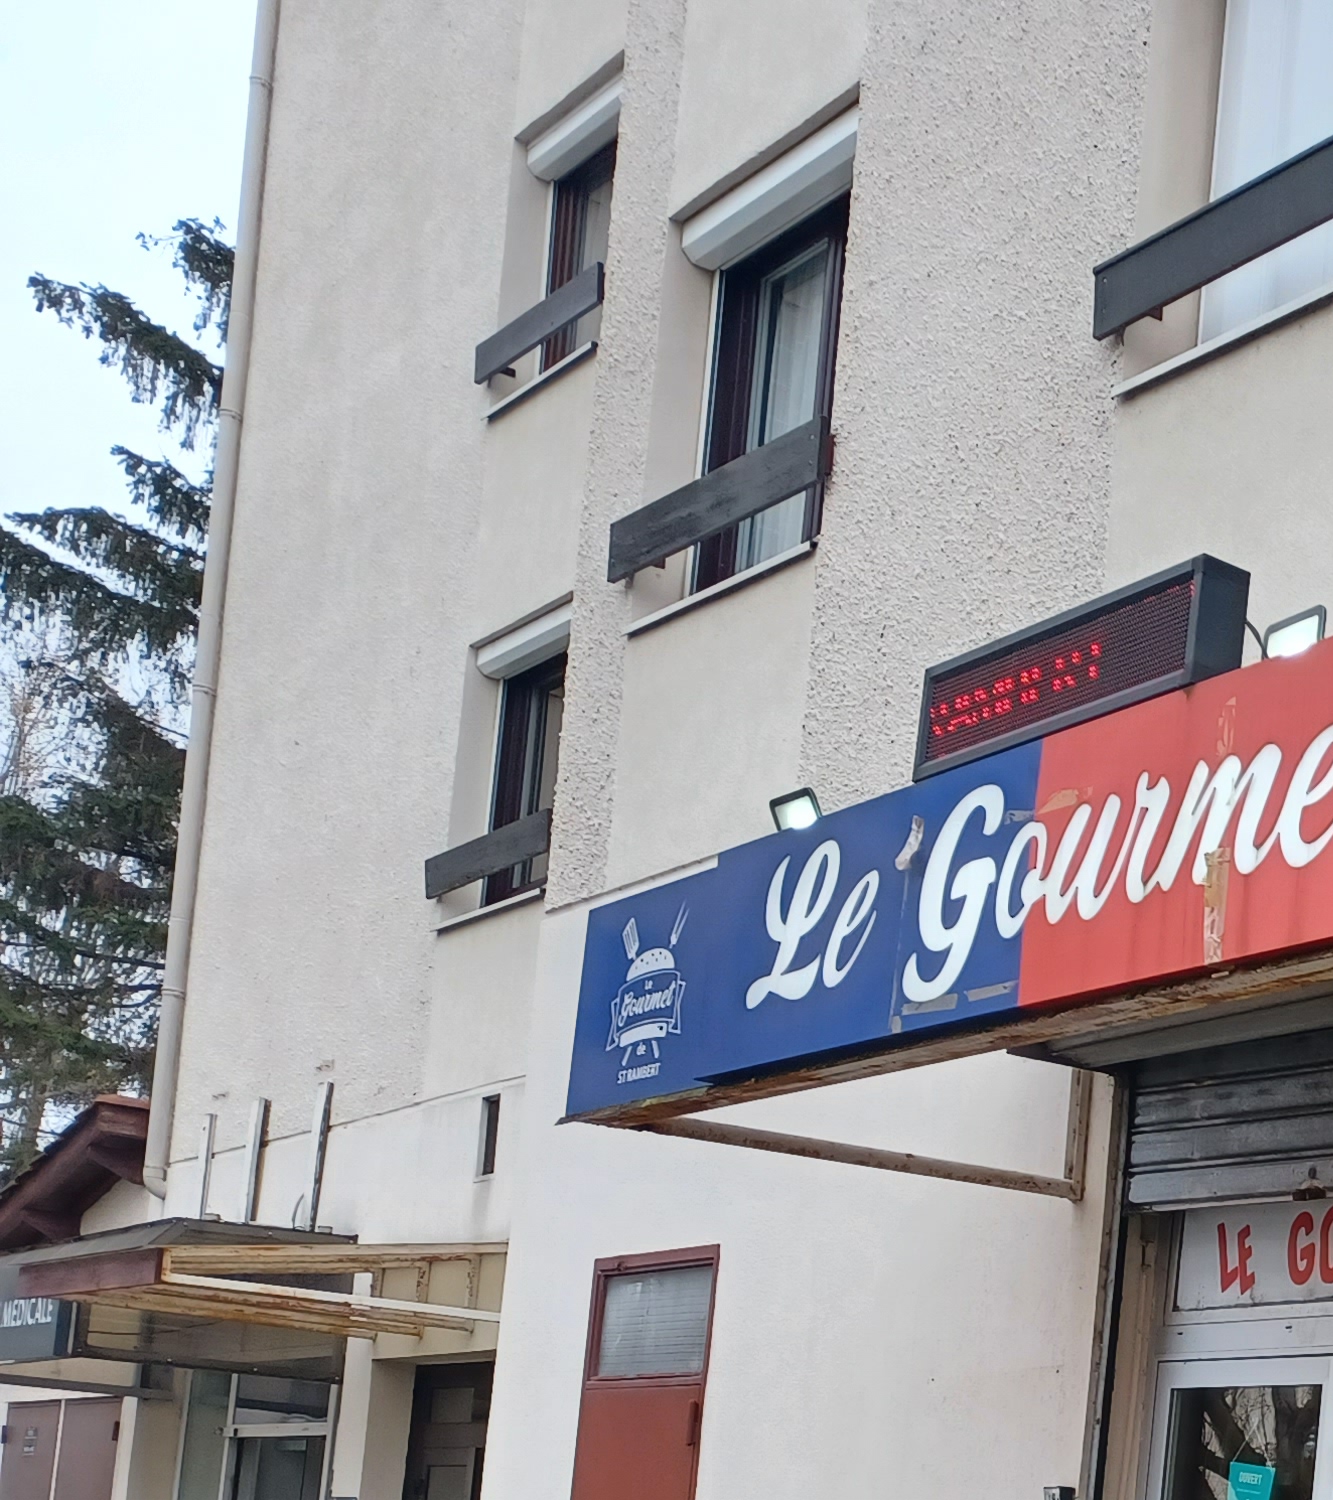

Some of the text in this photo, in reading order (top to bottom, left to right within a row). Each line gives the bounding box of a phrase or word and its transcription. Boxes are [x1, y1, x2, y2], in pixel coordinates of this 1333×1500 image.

[745, 840, 878, 1010] Le
[618, 980, 676, 1027] Gourmet
[617, 1063, 661, 1083] ST RAMBERT
[1216, 1222, 1256, 1295] LE
